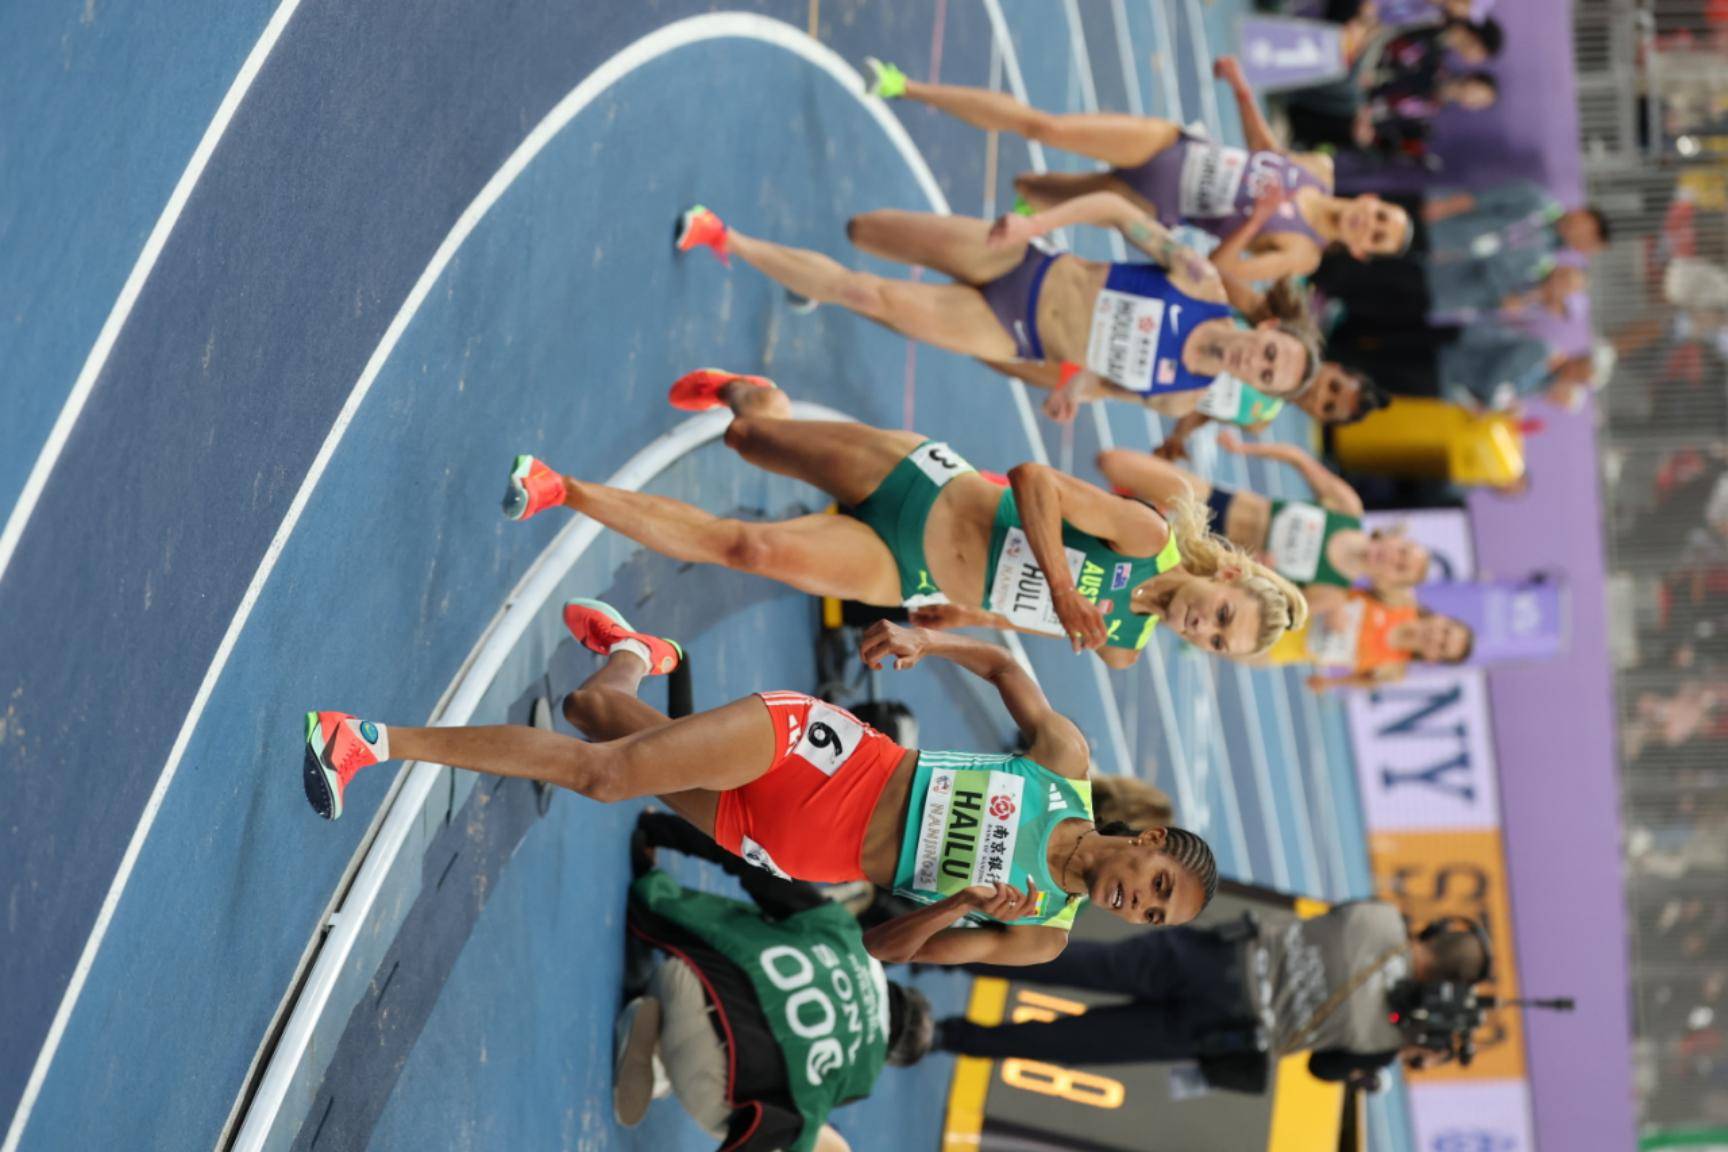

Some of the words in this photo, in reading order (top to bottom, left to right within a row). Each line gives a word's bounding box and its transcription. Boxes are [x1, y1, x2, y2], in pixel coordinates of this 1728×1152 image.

[929, 448, 958, 469] 3
[1013, 562, 1044, 613] HULL
[808, 721, 843, 757] 6
[942, 790, 983, 880] HAILU
[810, 943, 863, 1067] SONY
